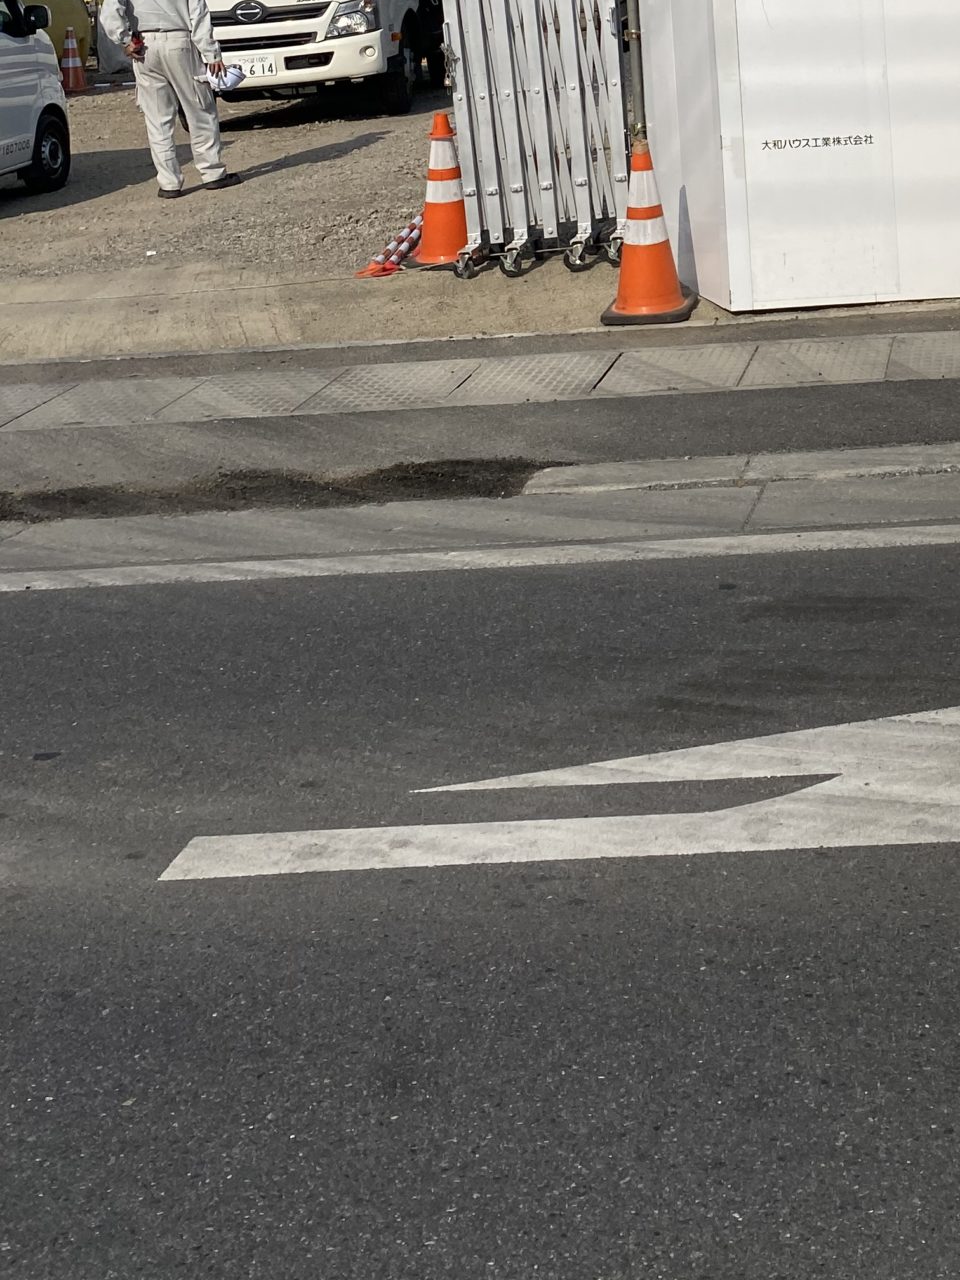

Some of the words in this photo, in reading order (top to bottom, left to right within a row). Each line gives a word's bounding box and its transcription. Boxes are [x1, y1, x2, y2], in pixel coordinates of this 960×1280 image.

[761, 134, 874, 151] 大和ハウス工業株式会社
